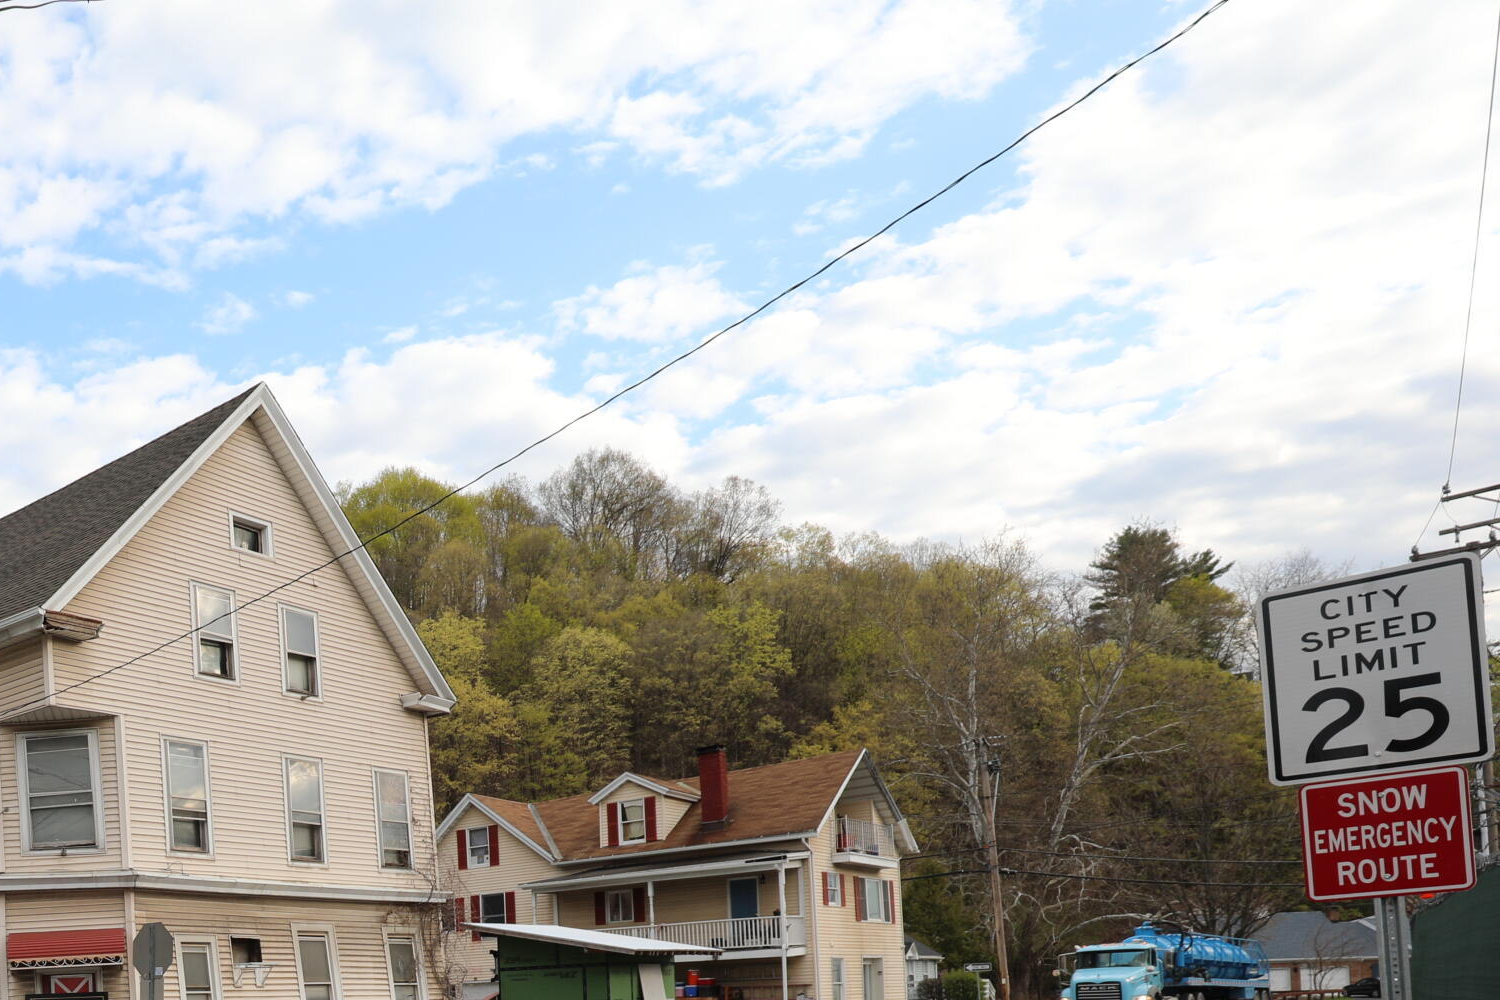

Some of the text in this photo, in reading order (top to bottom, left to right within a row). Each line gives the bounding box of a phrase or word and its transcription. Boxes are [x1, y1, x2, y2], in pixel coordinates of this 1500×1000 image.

[1320, 584, 1408, 620] CITY
[1301, 611, 1436, 653] SPEED
[1313, 641, 1426, 681] LIMIT
[1301, 671, 1450, 764] 25
[1337, 784, 1428, 818] SNOW
[1314, 815, 1457, 855] EMERGENCY
[1337, 852, 1440, 886] ROUTE
